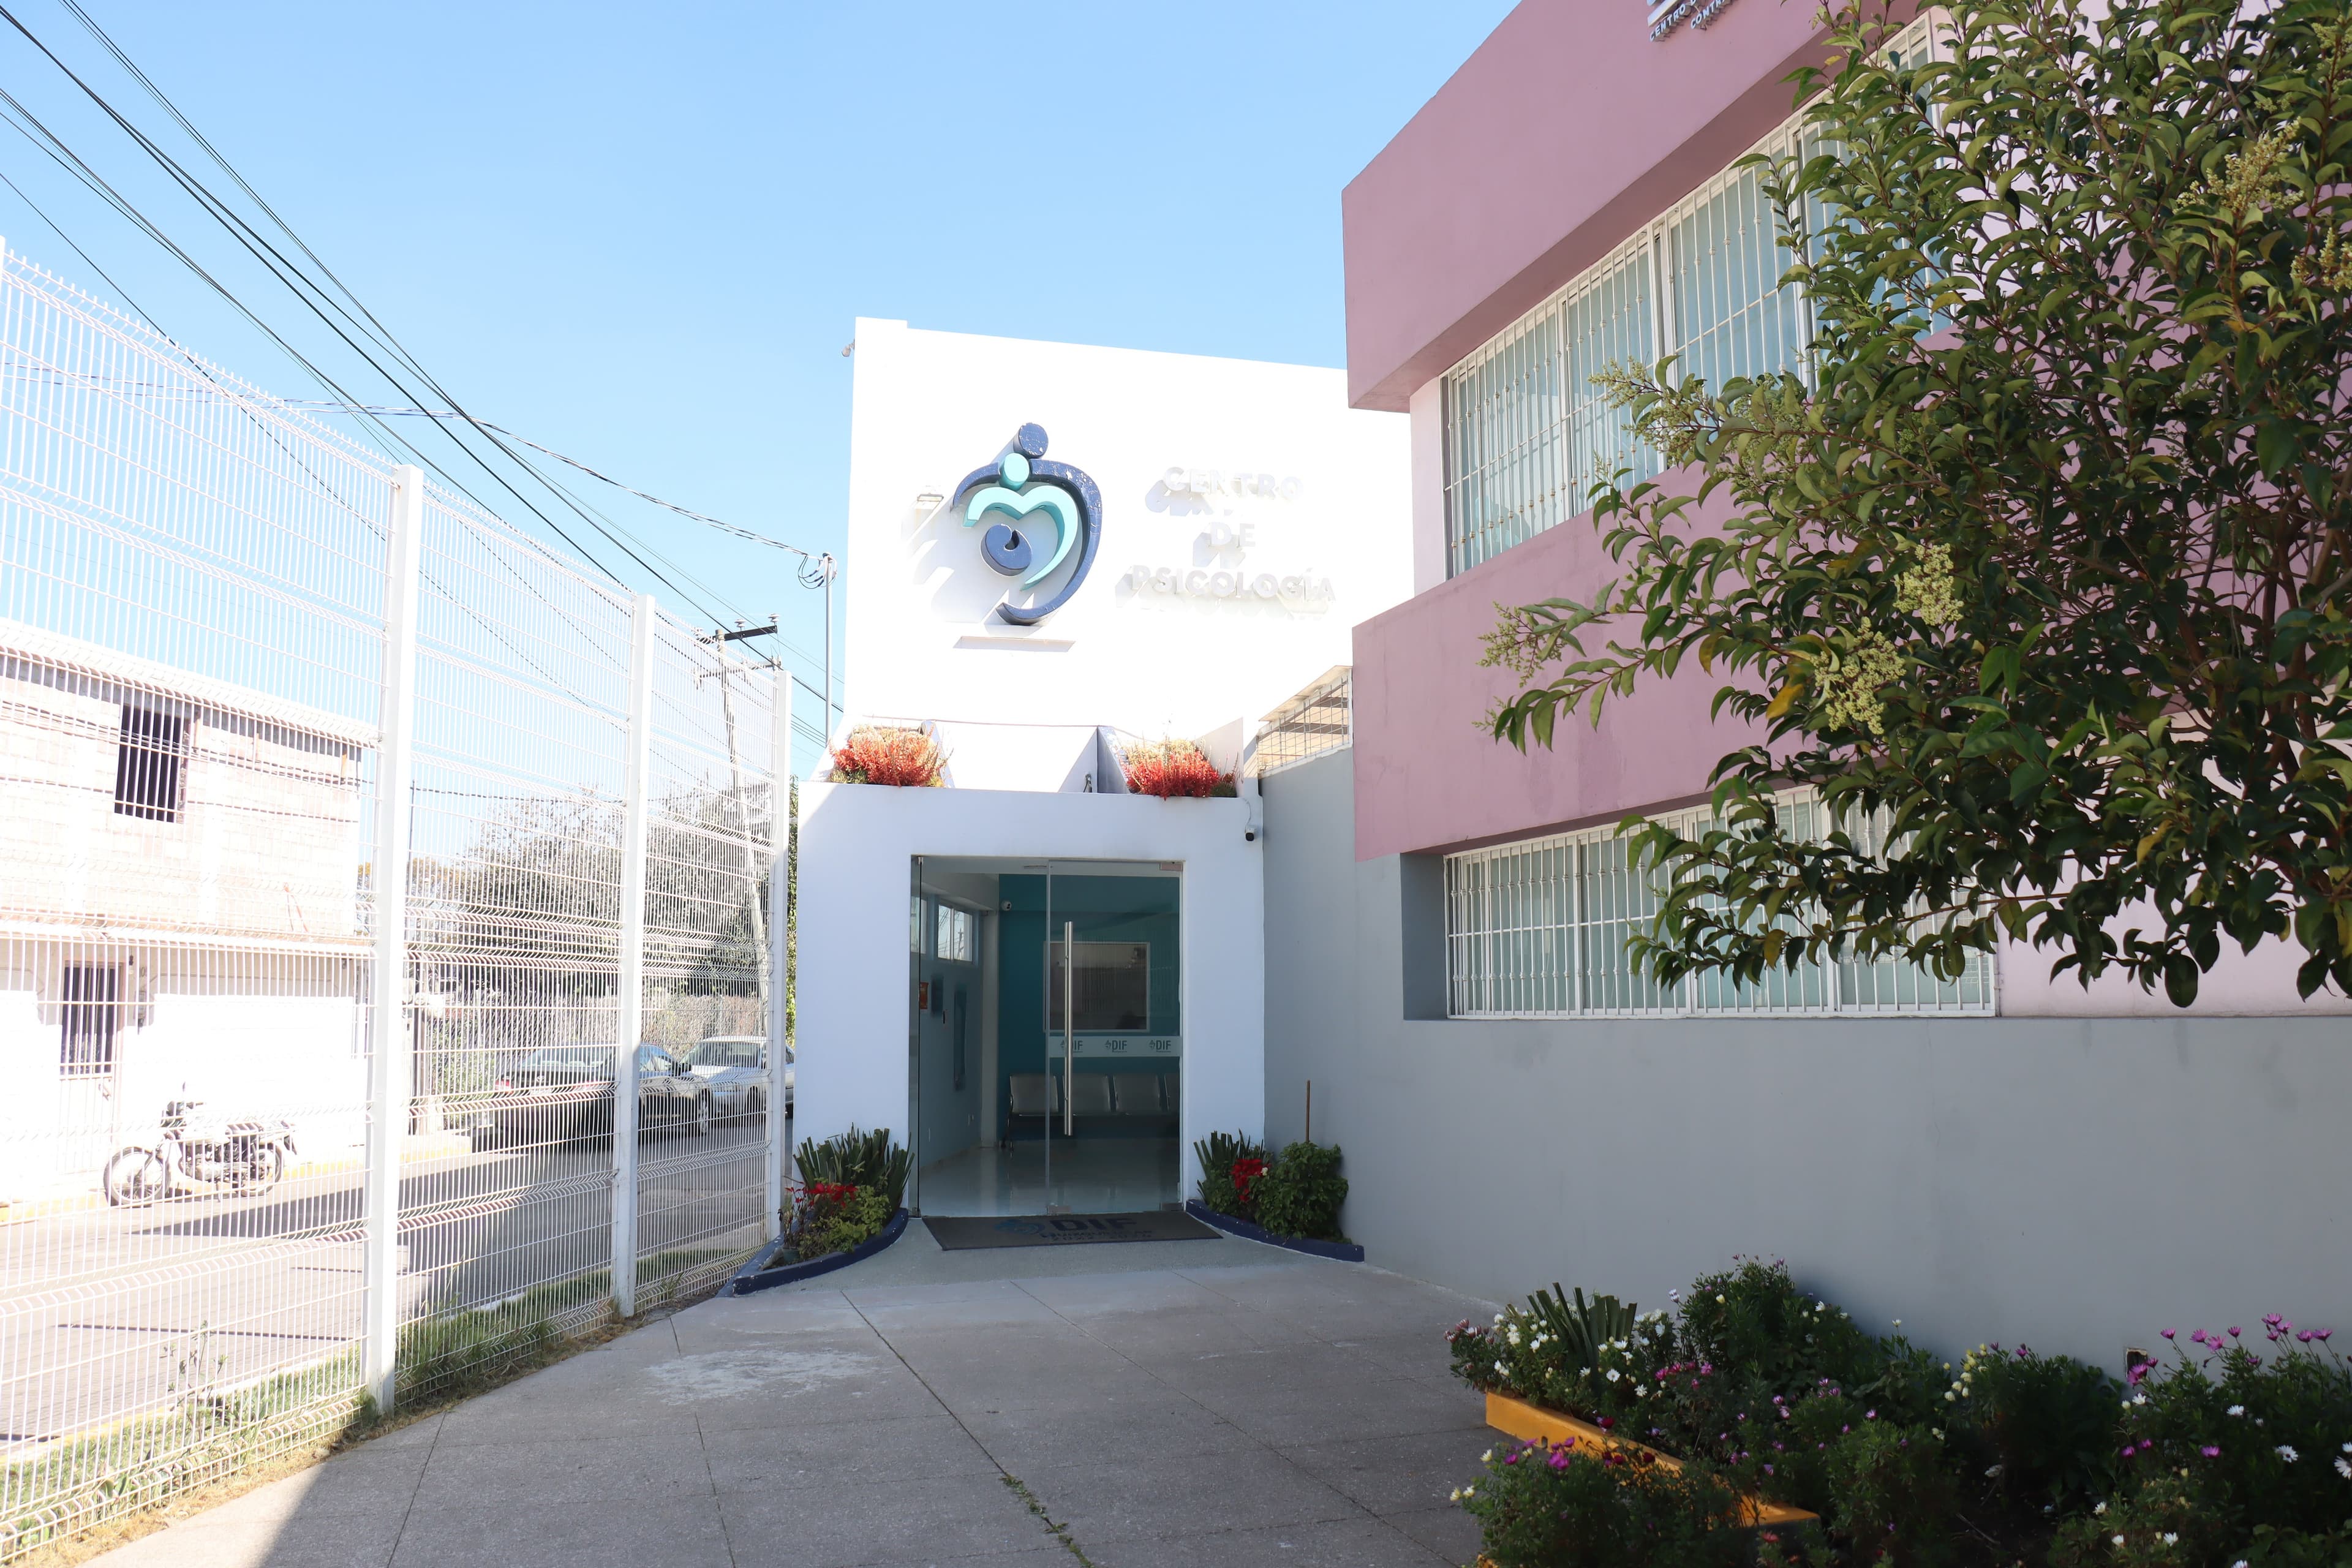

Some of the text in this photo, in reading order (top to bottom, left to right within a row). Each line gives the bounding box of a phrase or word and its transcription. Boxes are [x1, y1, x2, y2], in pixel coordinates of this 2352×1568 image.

[1650, 4, 1686, 42] CENTRO
[1691, 0, 1725, 29] CONTR
[1164, 466, 1304, 501] CENTRO
[1210, 521, 1256, 548] DE
[1131, 564, 1336, 602] PSICOLOGÍA
[1072, 1040, 1083, 1050] IF
[1112, 1040, 1128, 1050] DIF
[1156, 1040, 1171, 1050] DIF
[1049, 1218, 1137, 1231] DIF
